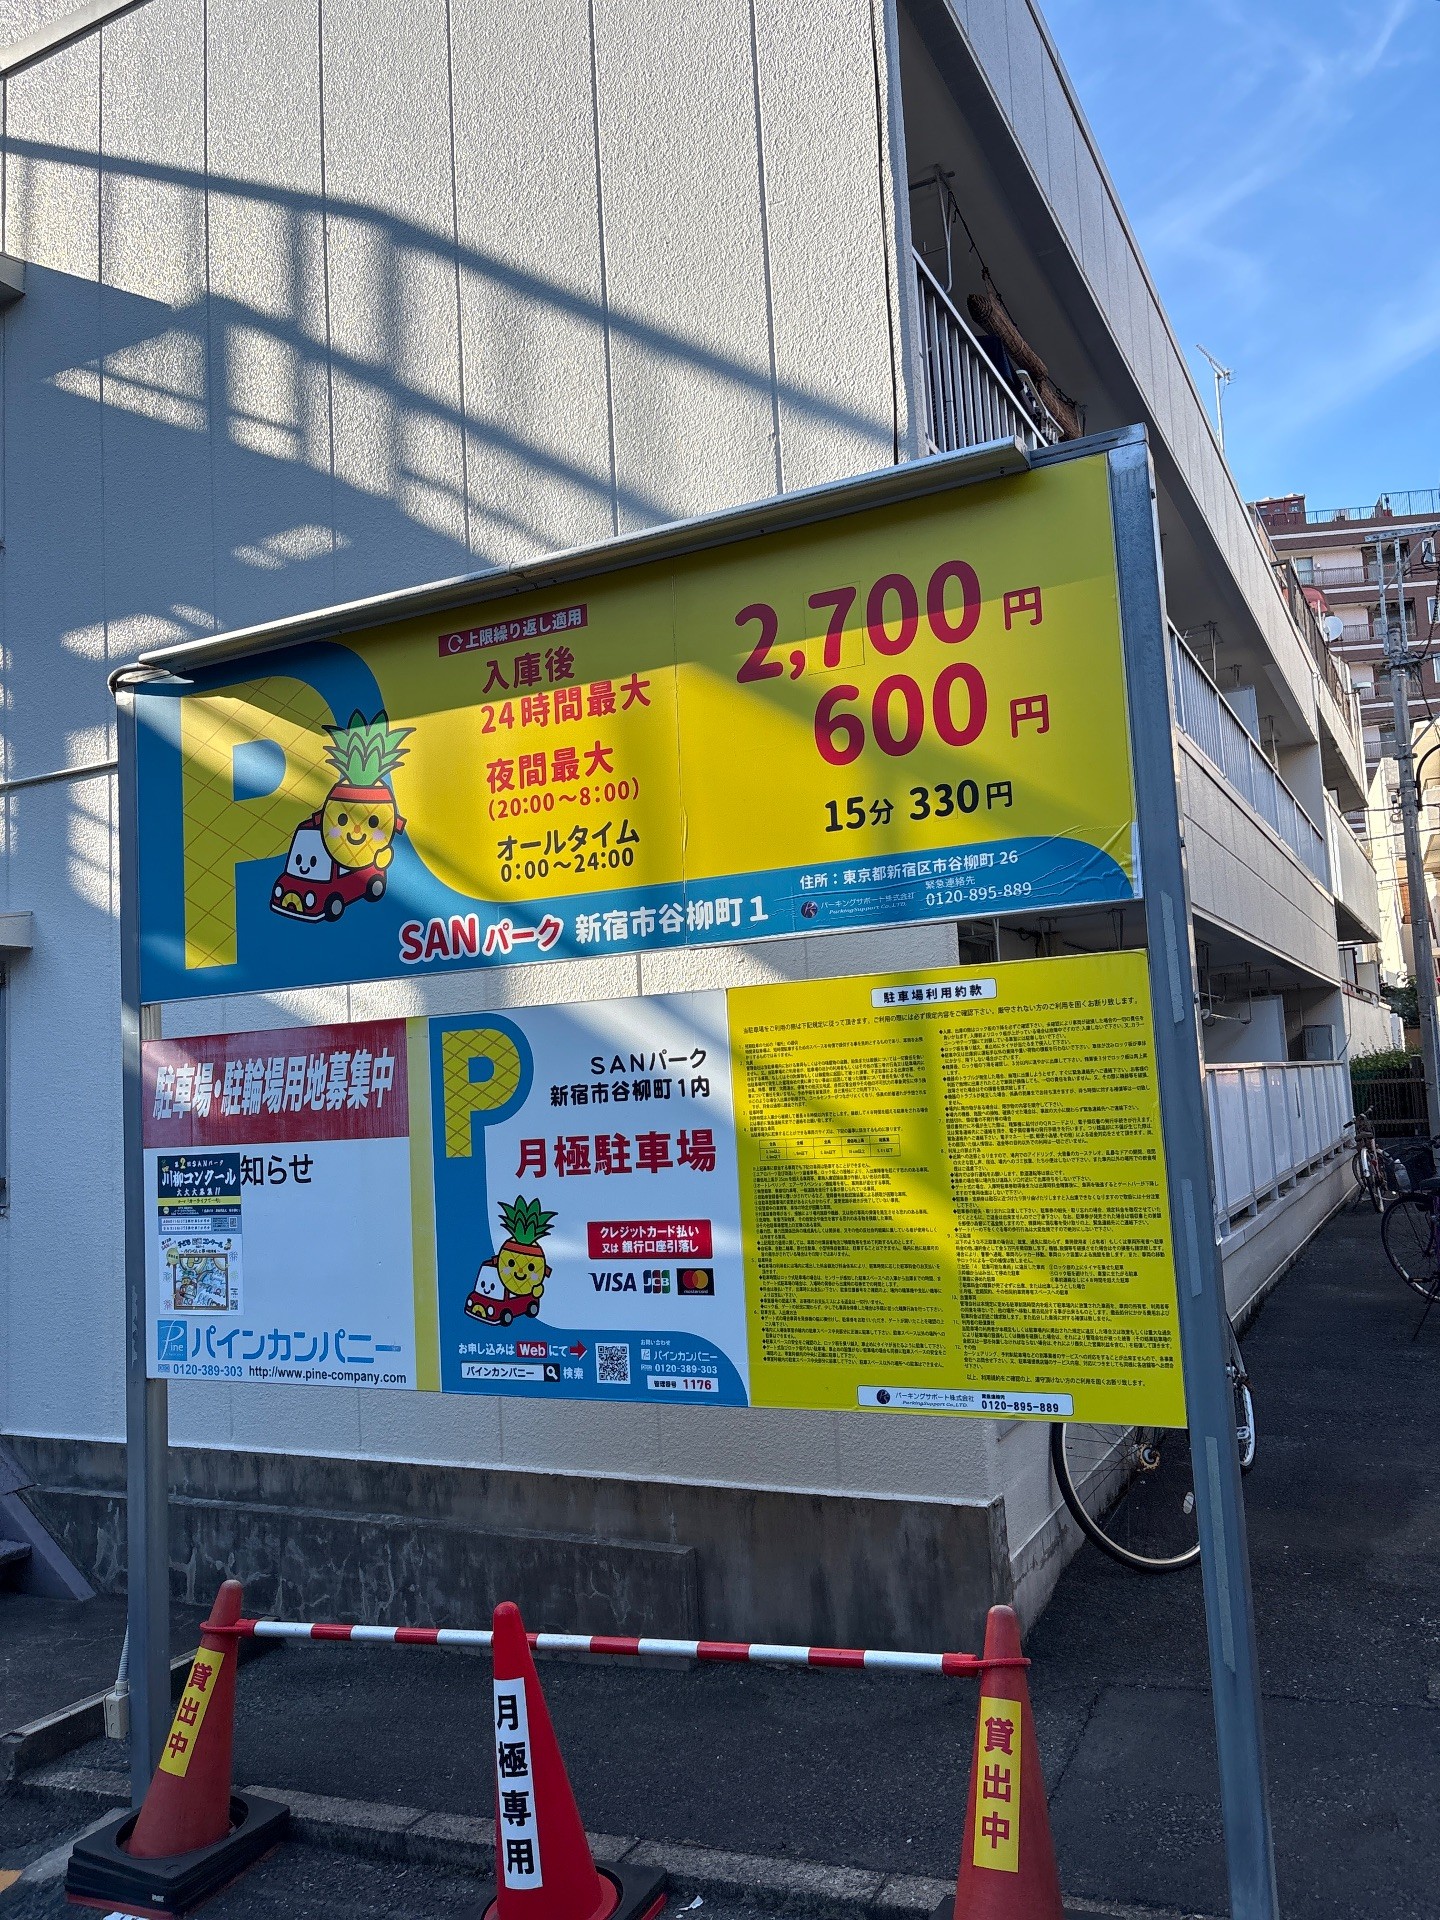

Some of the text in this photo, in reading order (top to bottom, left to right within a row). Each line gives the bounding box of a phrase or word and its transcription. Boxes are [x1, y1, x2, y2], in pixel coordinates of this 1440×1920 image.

[465, 606, 583, 650] 上限繰り返し適用
[734, 560, 1043, 684] 2,700 円
[481, 645, 576, 695] 入庫後
[480, 673, 652, 735] 24時間最大
[813, 662, 1050, 766] 600 円
[485, 740, 614, 795] 夜間最大
[824, 778, 1013, 833] 15分 330円
[497, 819, 641, 862] オールタイム
[925, 881, 1032, 907] 0120-895-889
[883, 983, 983, 1004] 駐車場利用約款
[590, 1047, 707, 1076] SANパーク
[152, 1047, 396, 1121] 駐車場・駐輪場用地募集中
[550, 1075, 711, 1108] 新宿市谷柳町1内
[515, 1128, 717, 1180] 月極駐車場
[600, 1224, 700, 1240] クレジットカード払い
[588, 1272, 638, 1292] VISA
[191, 1324, 402, 1364] パインカンパニー
[173, 1363, 407, 1386] 0120-389-303 http://www.pine-company.com
[562, 1366, 585, 1380] 検索
[654, 1363, 718, 1375] 0120-389-303
[683, 1378, 712, 1390] 1176
[981, 1400, 1059, 1413] 0120-895-889
[167, 1661, 214, 1760] 貸出中
[497, 1694, 535, 1876] 月極専用
[981, 1716, 1015, 1850] 貸出中
